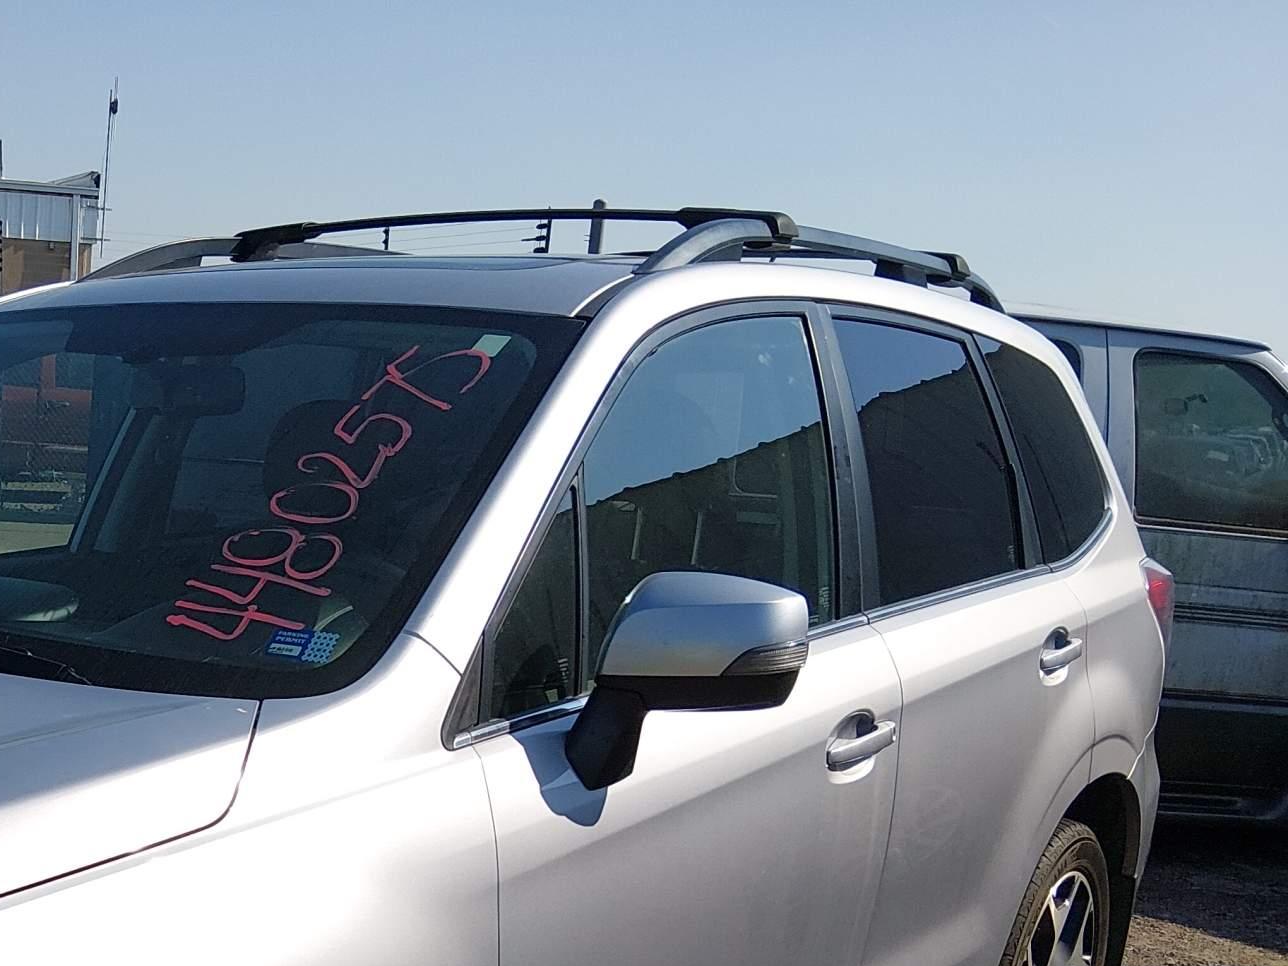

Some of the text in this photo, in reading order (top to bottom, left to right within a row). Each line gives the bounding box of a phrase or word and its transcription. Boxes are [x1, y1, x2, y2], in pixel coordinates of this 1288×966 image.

[166, 345, 491, 640] 44802575
[277, 630, 310, 639] PARKING
[274, 635, 306, 644] PERMIT
